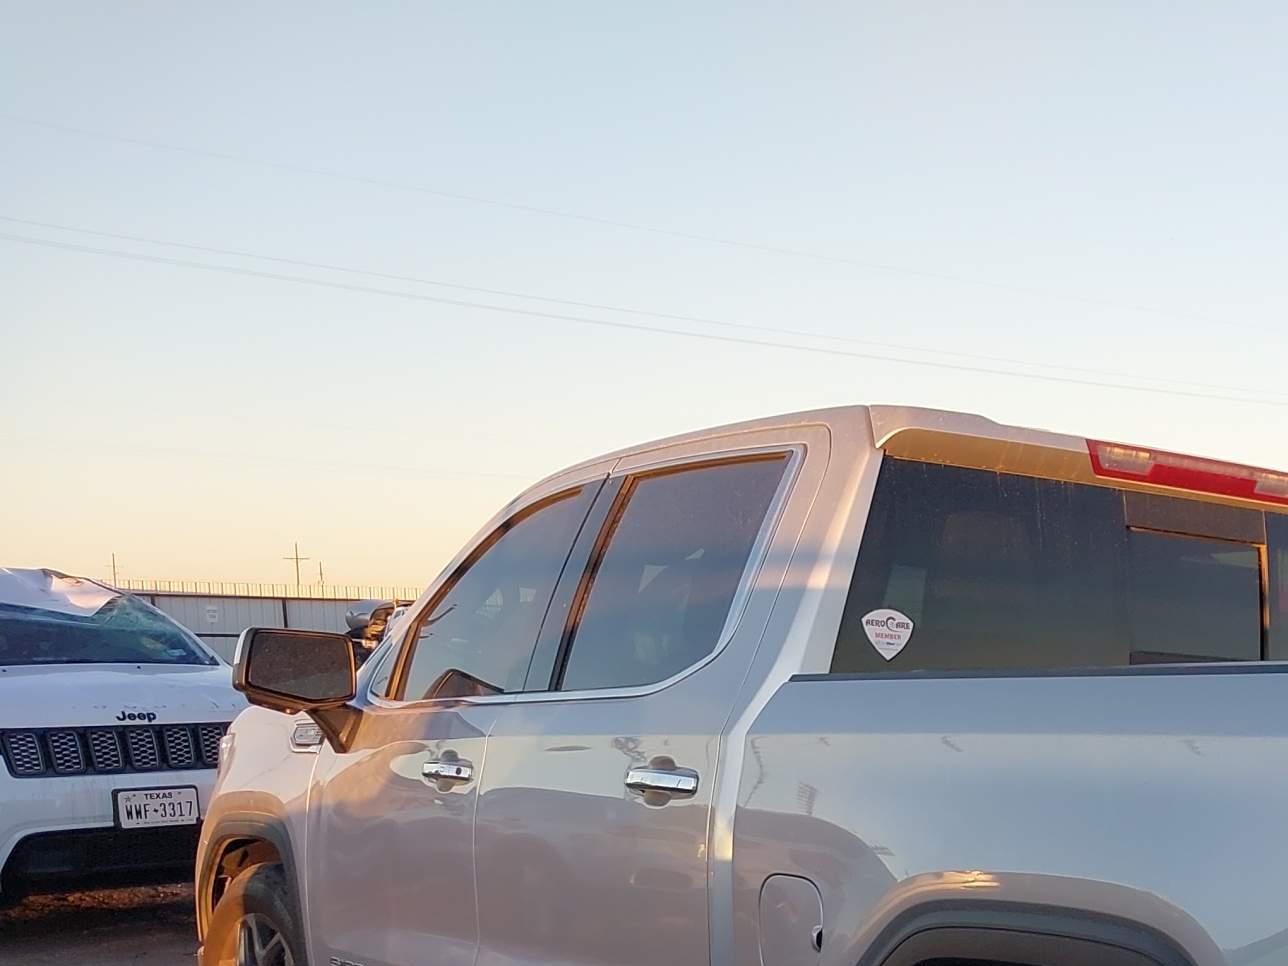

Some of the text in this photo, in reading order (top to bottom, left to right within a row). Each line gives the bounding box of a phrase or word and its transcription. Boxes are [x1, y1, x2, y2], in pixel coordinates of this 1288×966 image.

[874, 632, 902, 640] MEMBER
[115, 710, 157, 723] Jeep
[144, 791, 173, 800] TEXAS
